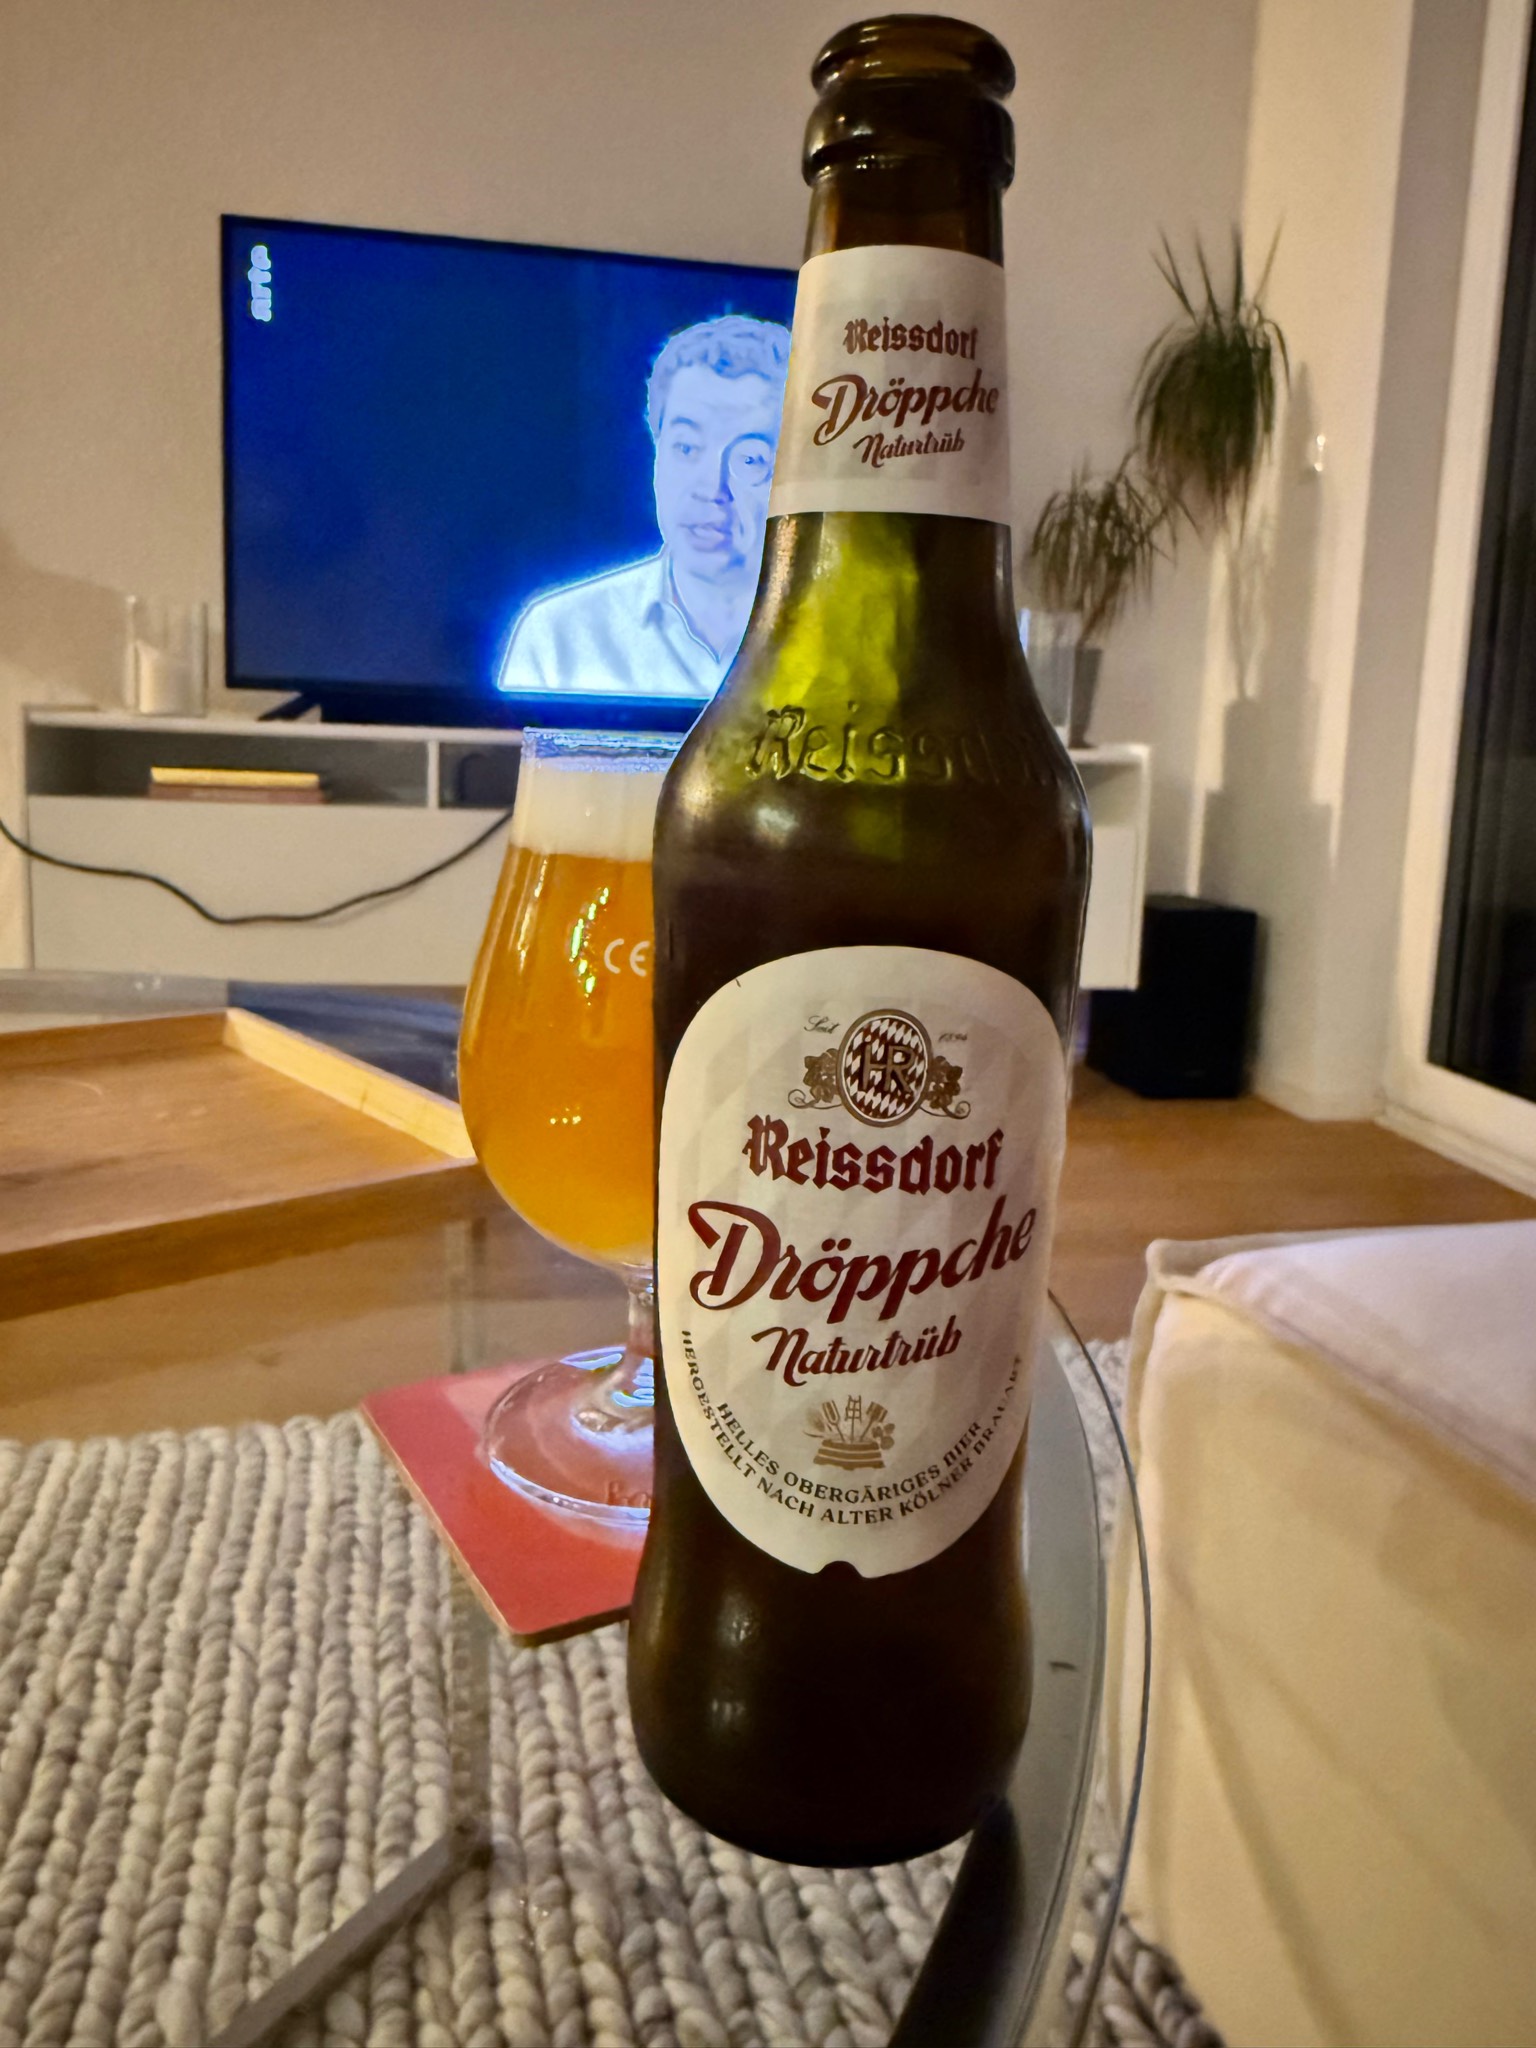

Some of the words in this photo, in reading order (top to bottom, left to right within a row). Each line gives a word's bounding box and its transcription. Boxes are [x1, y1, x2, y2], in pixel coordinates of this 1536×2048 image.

[843, 317, 978, 360] Reissdorf
[811, 369, 999, 446] Dröppche
[853, 428, 965, 468] Naturtrüb
[745, 700, 1052, 783] Reiss
[742, 1115, 1004, 1195] Reissdorf
[688, 1194, 1037, 1324] Dröppche
[751, 1315, 962, 1387] Naturtrüb
[682, 1330, 757, 1478] HERGESTELLT
[757, 1477, 815, 1517] NACH
[821, 1506, 893, 1525] ALTER
[899, 1457, 974, 1517] KÖLNER
[717, 1403, 780, 1475] HELLES
[784, 1464, 941, 1504] OBERGÄRIGES
